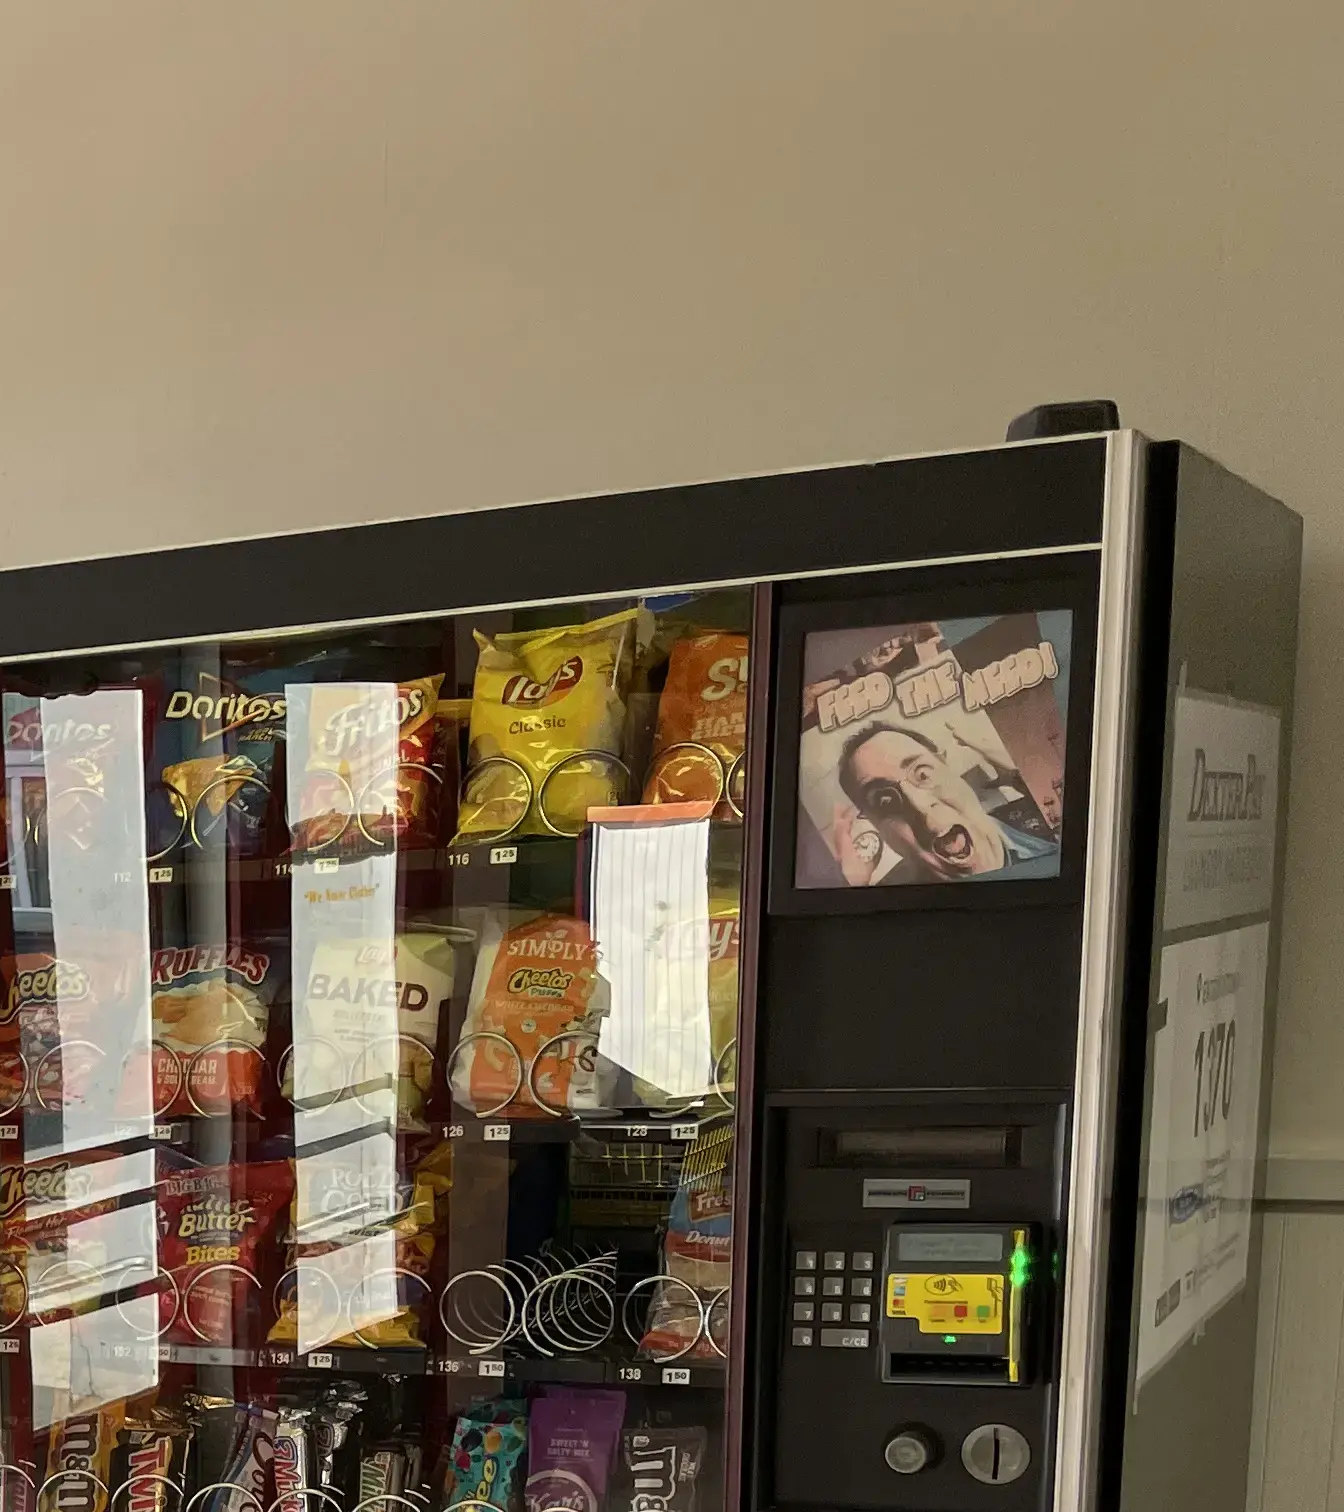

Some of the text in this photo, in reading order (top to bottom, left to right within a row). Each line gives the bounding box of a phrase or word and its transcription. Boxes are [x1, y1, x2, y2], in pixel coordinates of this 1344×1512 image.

[816, 670, 894, 733] FEED
[894, 659, 962, 719] THE
[961, 641, 1060, 713] NEED!
[165, 690, 287, 723] Doritos
[508, 714, 567, 735] Classic
[275, 864, 293, 876] 114
[447, 853, 469, 867] 116
[507, 938, 589, 962] SIMPLY
[152, 947, 271, 985] RUFFLES
[508, 967, 574, 994] Cheetos
[310, 973, 430, 1012] BAKED
[442, 1125, 464, 1138] 126
[627, 1125, 648, 1137] 128
[178, 1211, 256, 1238] Butter
[185, 1245, 241, 1265] Bites
[270, 1353, 290, 1364] 134
[438, 1361, 459, 1373] 136
[619, 1368, 641, 1380] 138
